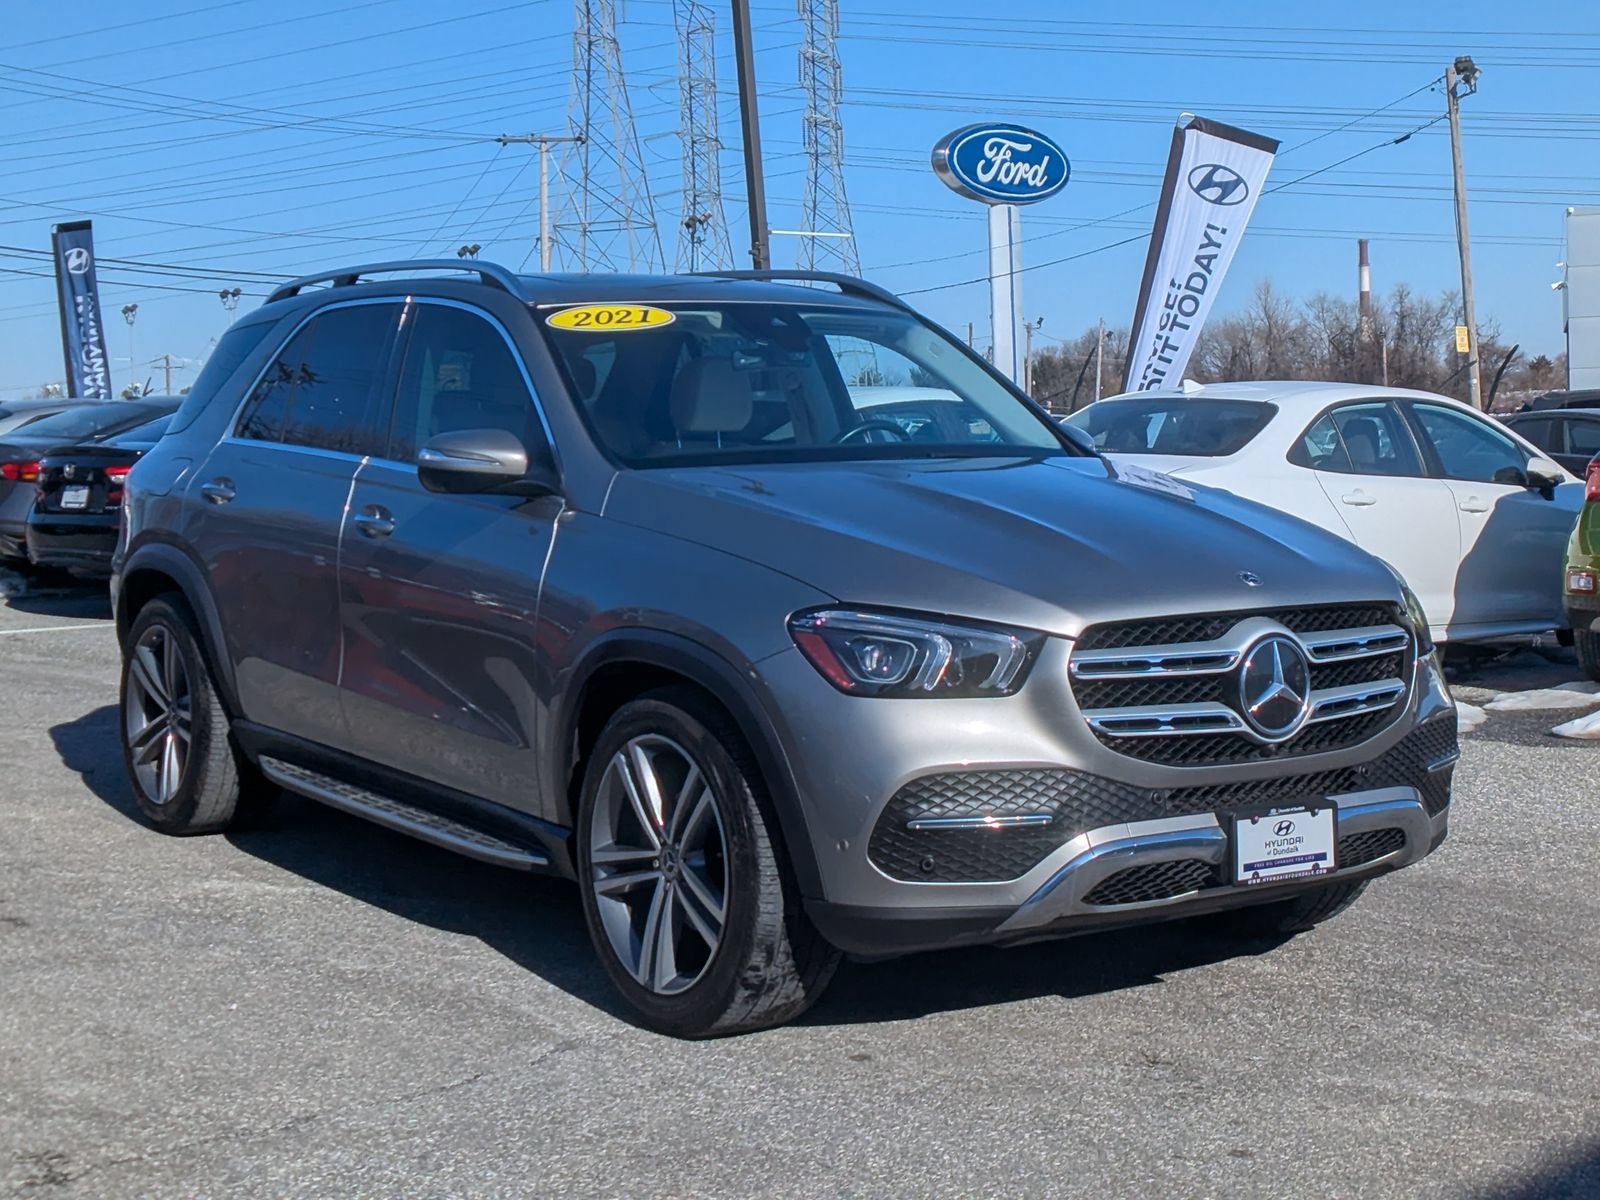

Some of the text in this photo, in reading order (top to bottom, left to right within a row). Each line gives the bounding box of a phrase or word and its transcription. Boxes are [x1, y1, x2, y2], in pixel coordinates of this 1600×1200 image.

[976, 137, 1050, 187] Ford
[1168, 223, 1228, 331] TODAY!
[573, 309, 651, 327] 2021
[1264, 836, 1304, 848] HYUNDAI
[1272, 846, 1299, 856] Dundalk
